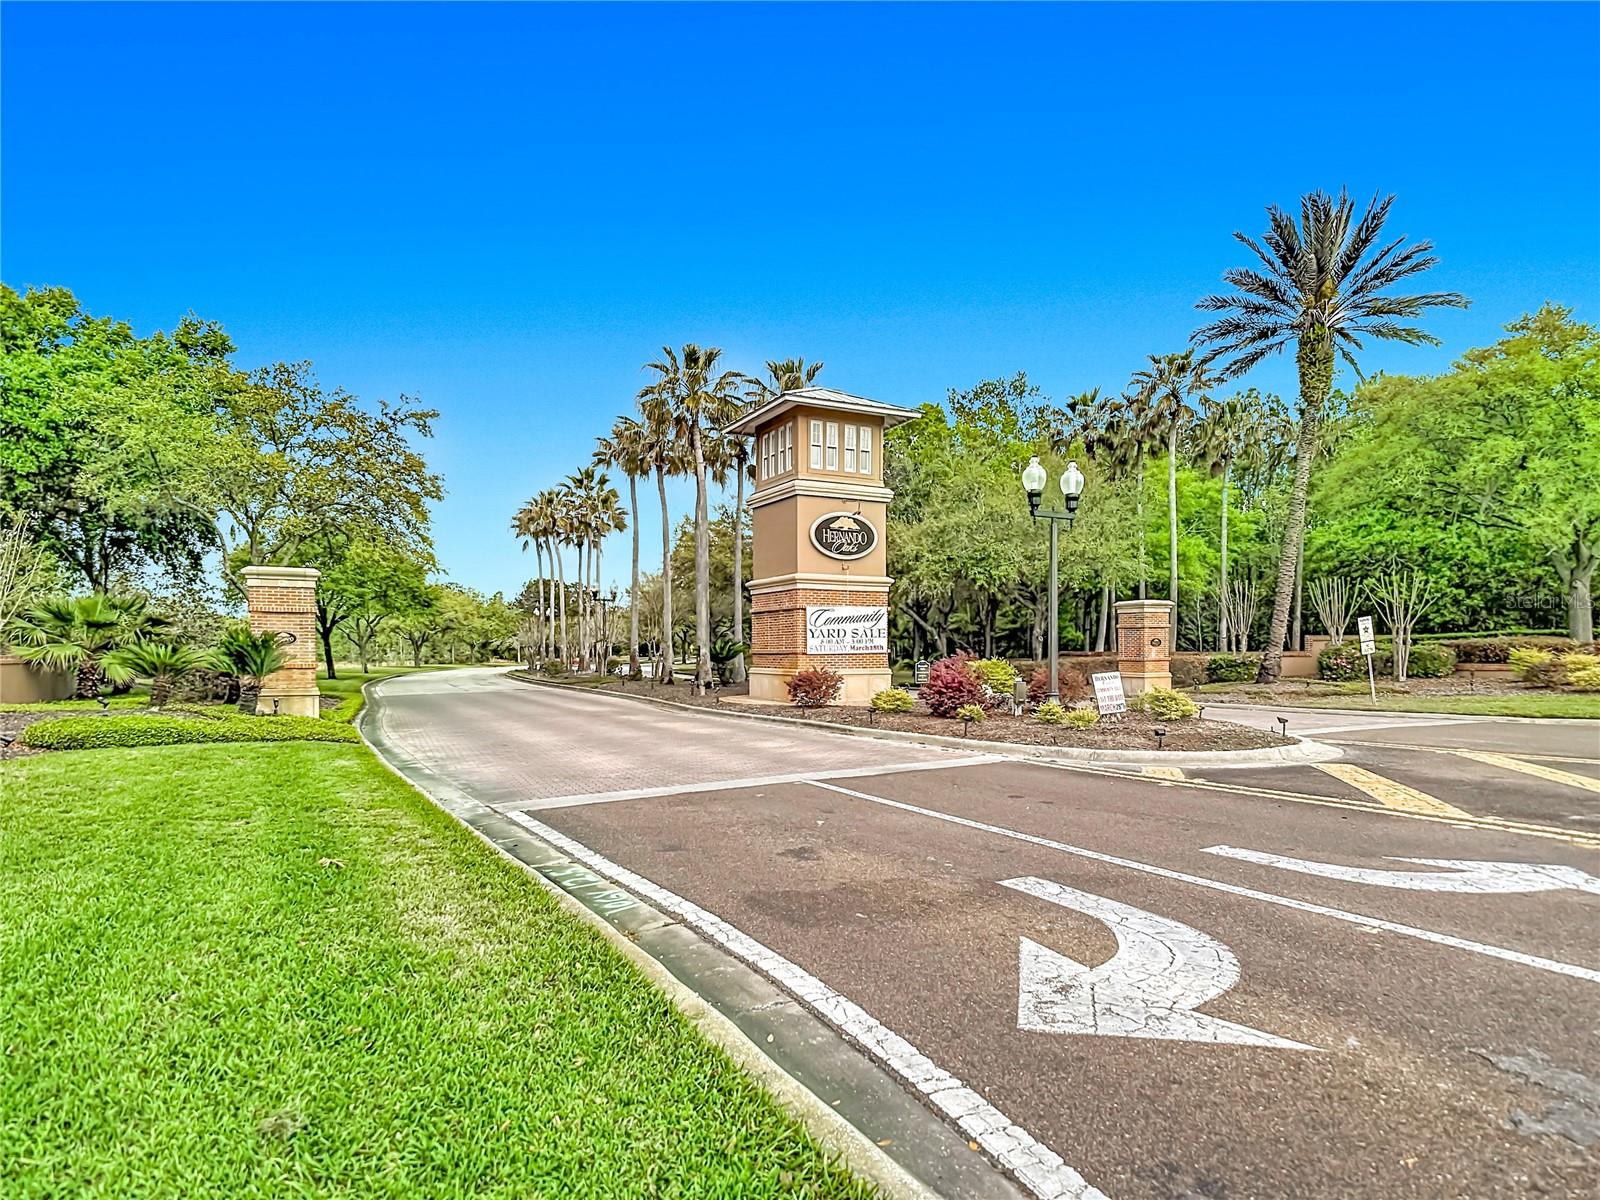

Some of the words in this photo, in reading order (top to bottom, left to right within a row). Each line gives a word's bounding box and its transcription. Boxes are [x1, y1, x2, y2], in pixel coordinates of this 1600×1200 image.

[822, 529, 867, 545] HERNANDO
[809, 608, 885, 629] Community
[809, 628, 847, 639] YARD
[851, 628, 886, 639] SALE
